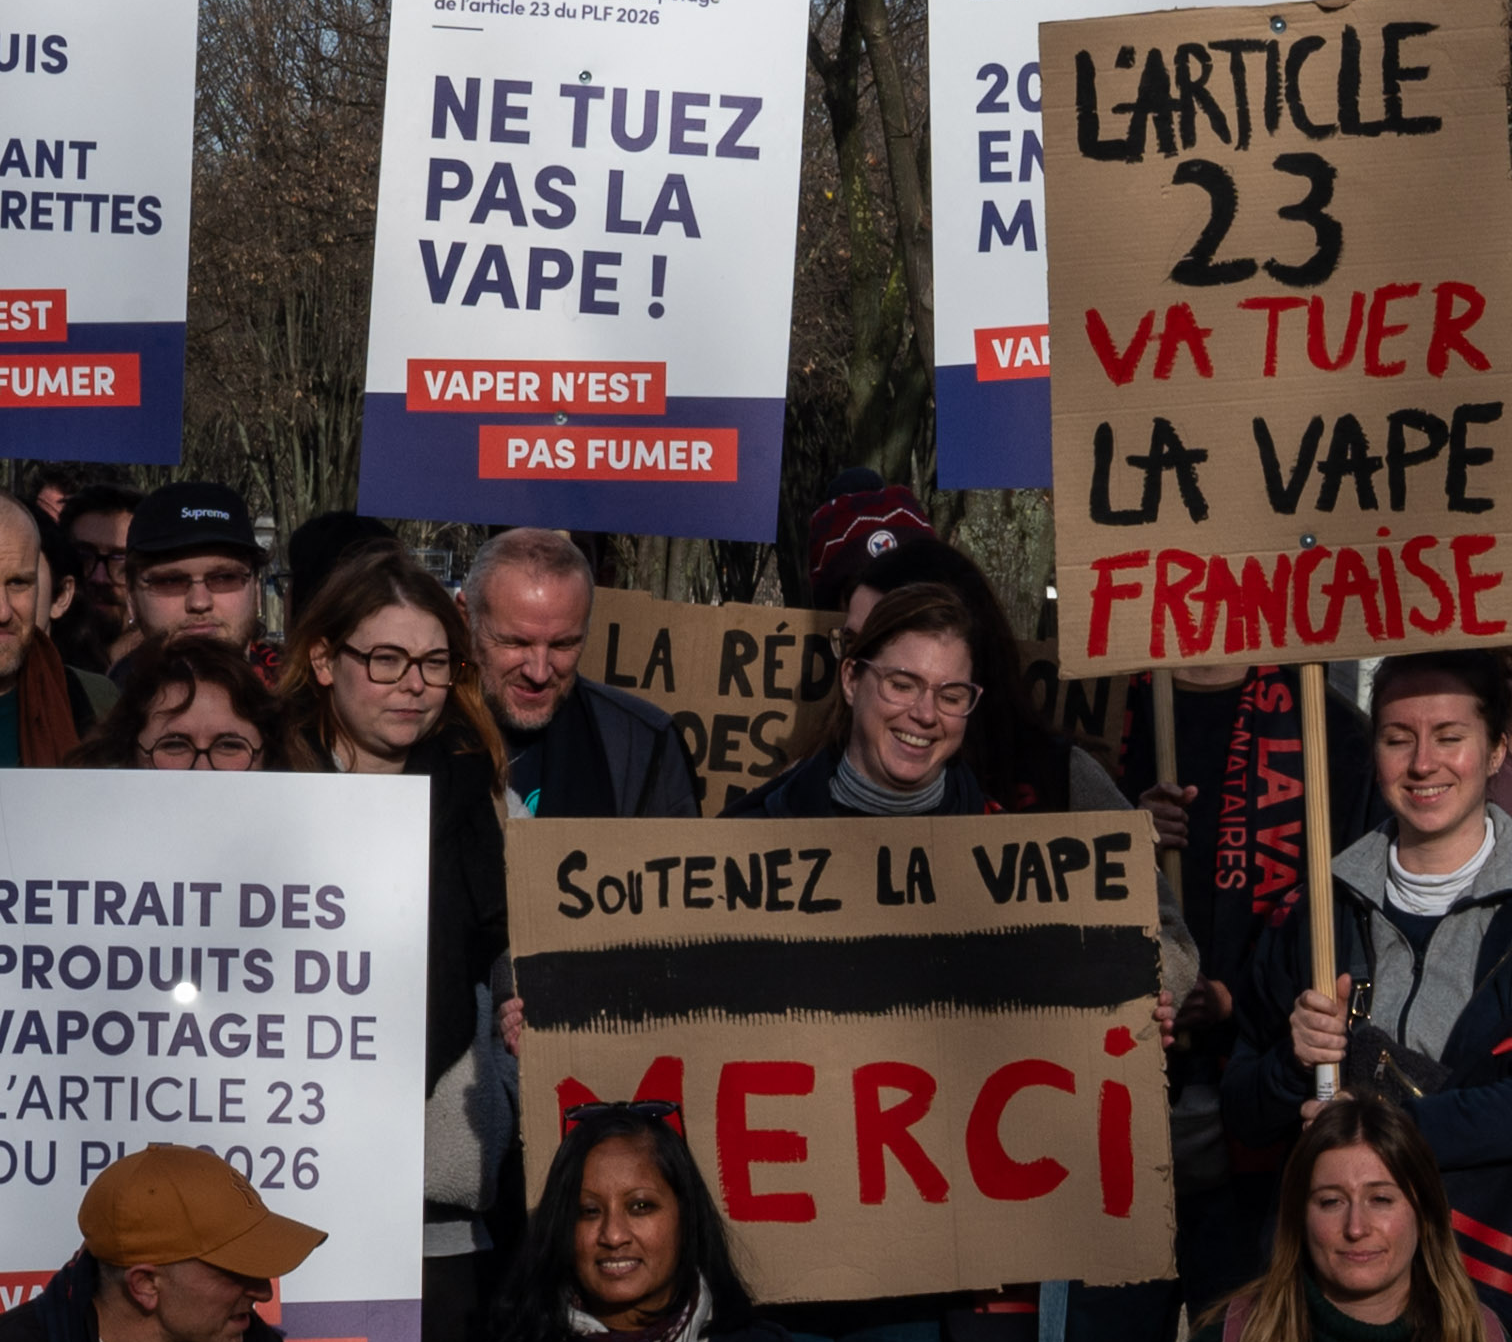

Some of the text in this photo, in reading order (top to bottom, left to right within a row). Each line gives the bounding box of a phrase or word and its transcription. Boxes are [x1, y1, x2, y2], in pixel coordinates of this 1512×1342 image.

[529, 1, 550, 17] 23
[554, 2, 577, 19] du
[581, 4, 614, 22] PLF
[616, 7, 660, 25] 2026
[1167, 152, 1344, 289] 23
[1085, 302, 1214, 387] VA
[1238, 281, 1491, 378] TUER
[1089, 401, 1504, 527] LA VAPE
[181, 507, 230, 521] Supreme
[595, 622, 676, 701] LA
[876, 845, 937, 906] LA
[971, 831, 1132, 905] VAPE
[238, 882, 346, 930] DES
[294, 949, 371, 996] DU
[306, 1014, 377, 1061] DE
[266, 1080, 326, 1126] 23
